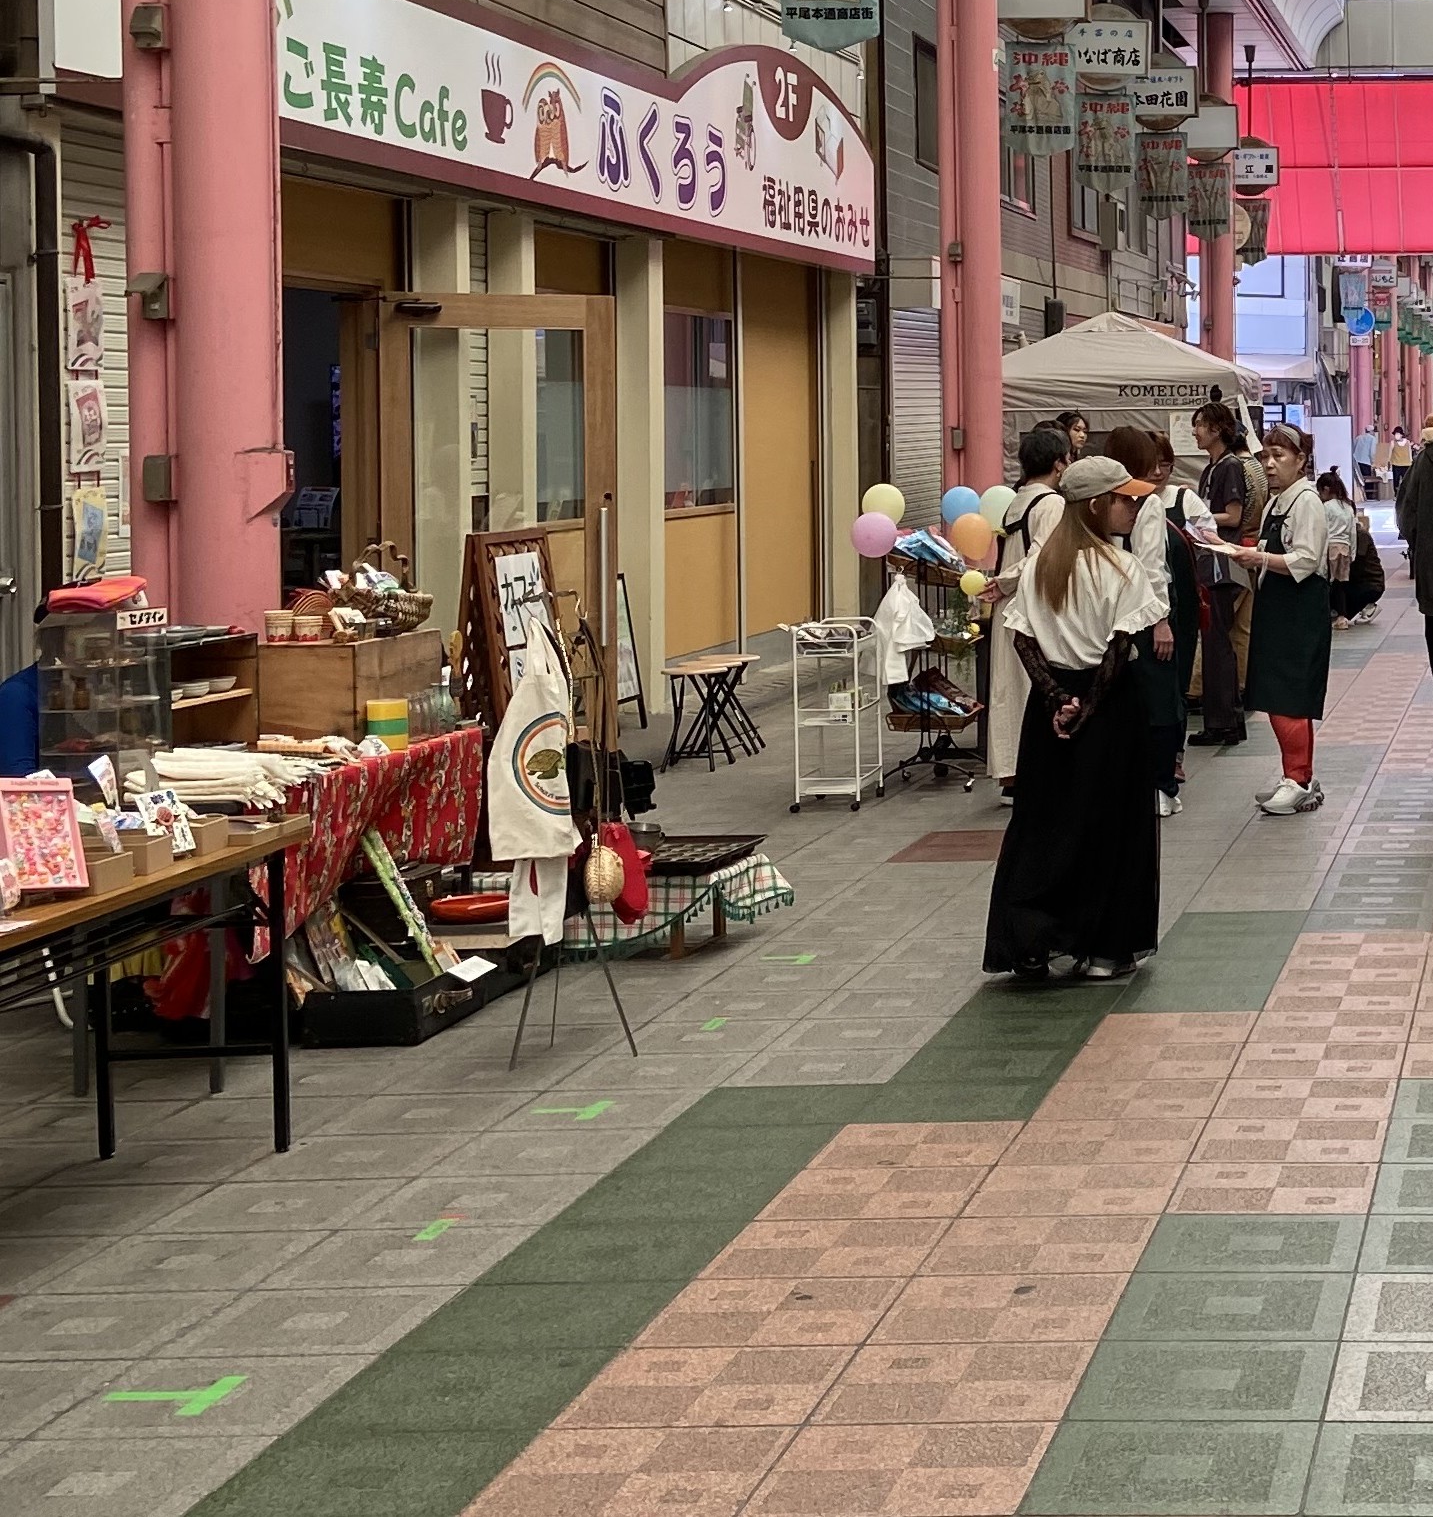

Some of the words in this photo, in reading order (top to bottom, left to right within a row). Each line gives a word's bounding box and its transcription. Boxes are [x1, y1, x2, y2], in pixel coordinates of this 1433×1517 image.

[786, 7, 873, 20] 平尾本通商店街
[1012, 52, 1069, 67] 沖縄
[775, 66, 798, 123] 2F
[1081, 101, 1130, 114] 沖縄
[597, 87, 727, 218] ふくろう
[762, 175, 870, 248] 福祉用具のおみせ
[1118, 384, 1208, 397] KOMEICHI
[1154, 397, 1178, 406] RICE
